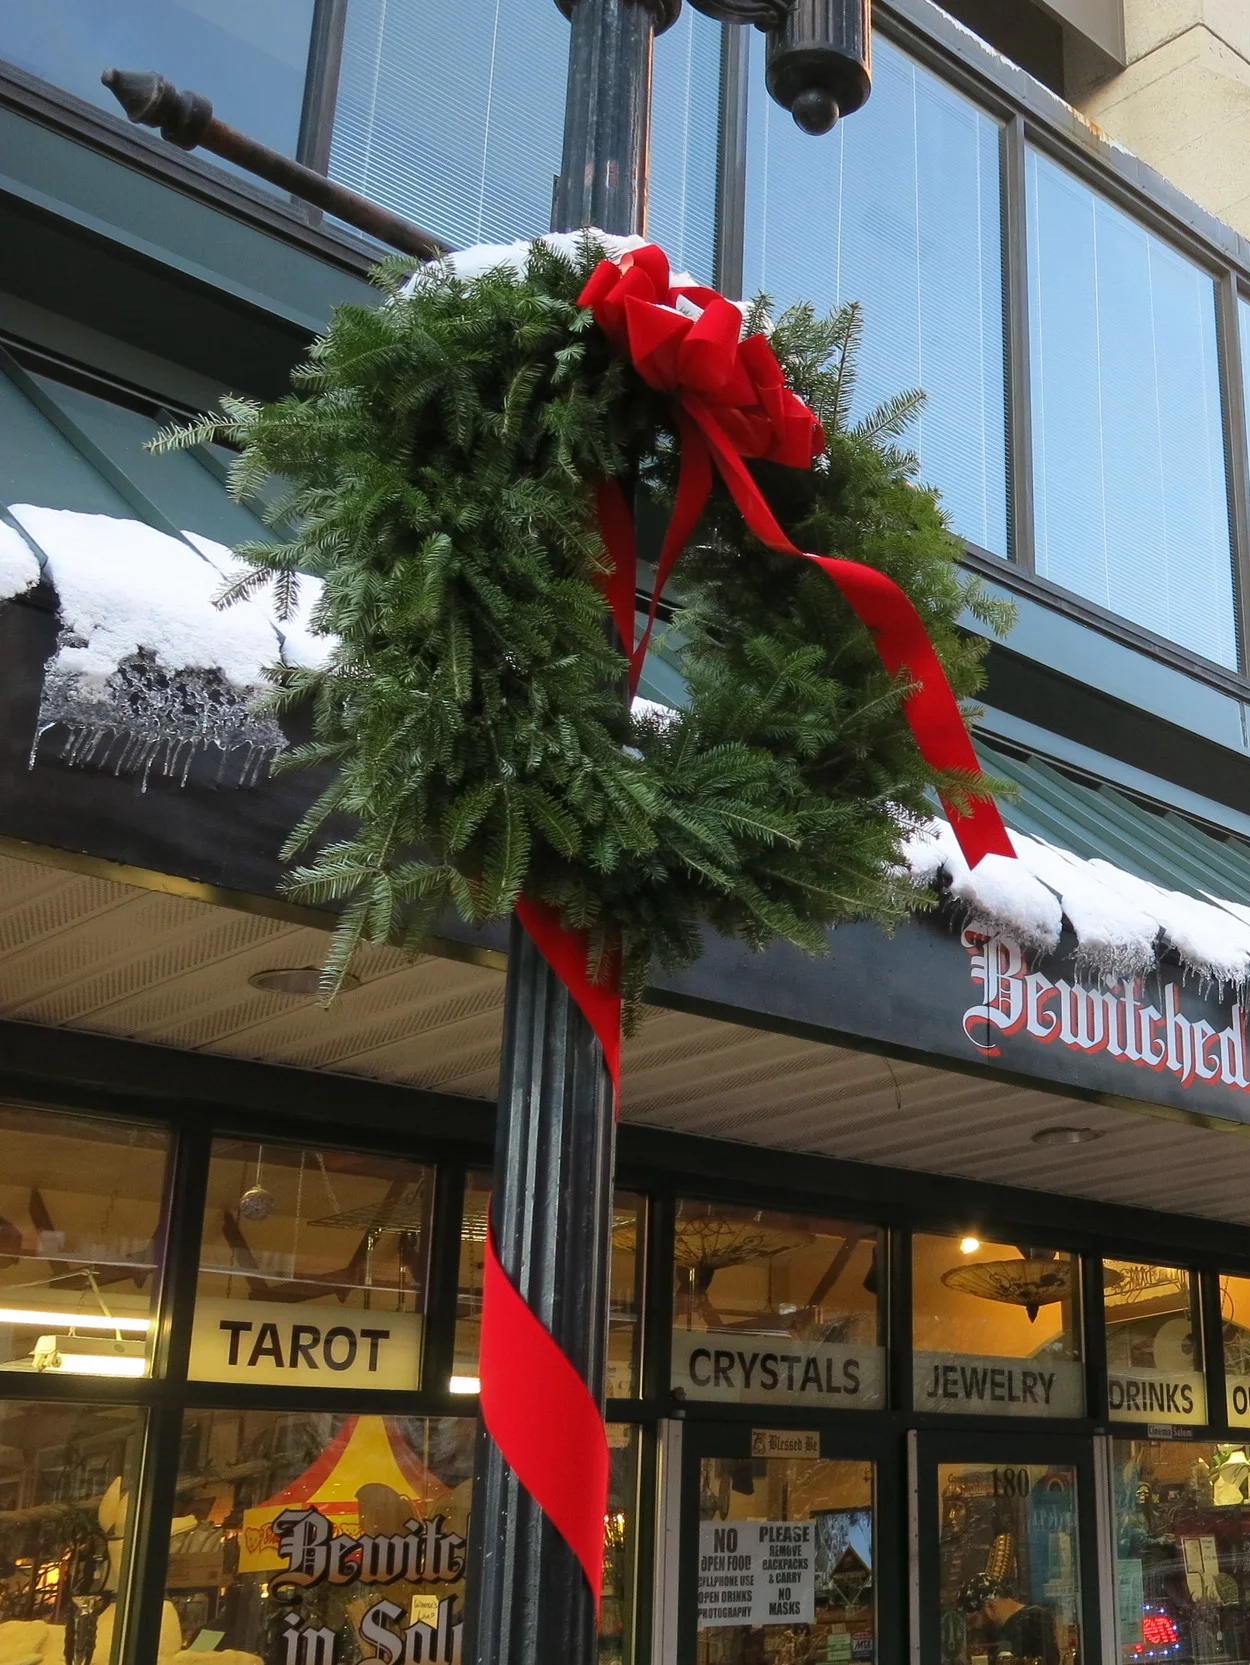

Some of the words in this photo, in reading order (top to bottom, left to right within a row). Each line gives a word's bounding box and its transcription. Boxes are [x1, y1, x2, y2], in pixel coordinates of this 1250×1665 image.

[219, 1320, 390, 1372] TAROT
[689, 1348, 861, 1394] CRYSTALS
[927, 1364, 1055, 1404] JEWELRY
[1108, 1380, 1193, 1414] DRINKS
[768, 1434, 802, 1451] Blessed
[804, 1435, 818, 1452] Be
[992, 1469, 1030, 1498] 180
[713, 1528, 738, 1553] NO
[759, 1526, 810, 1543] PLEASE
[268, 1505, 470, 1604] Bewitc
[769, 1545, 802, 1557] REMOVE
[701, 1555, 725, 1572] OPEN
[727, 1555, 751, 1571] FOOD
[762, 1558, 809, 1571] BACKPACKS
[740, 1575, 754, 1586] USE
[776, 1571, 802, 1584] CARRY
[699, 1591, 720, 1604] OPEN
[721, 1590, 752, 1603] DRINKS
[778, 1587, 791, 1601] NO
[699, 1606, 752, 1619] PHOTOGRAPHY
[769, 1602, 801, 1616] MASKS
[282, 1612, 337, 1665] in
